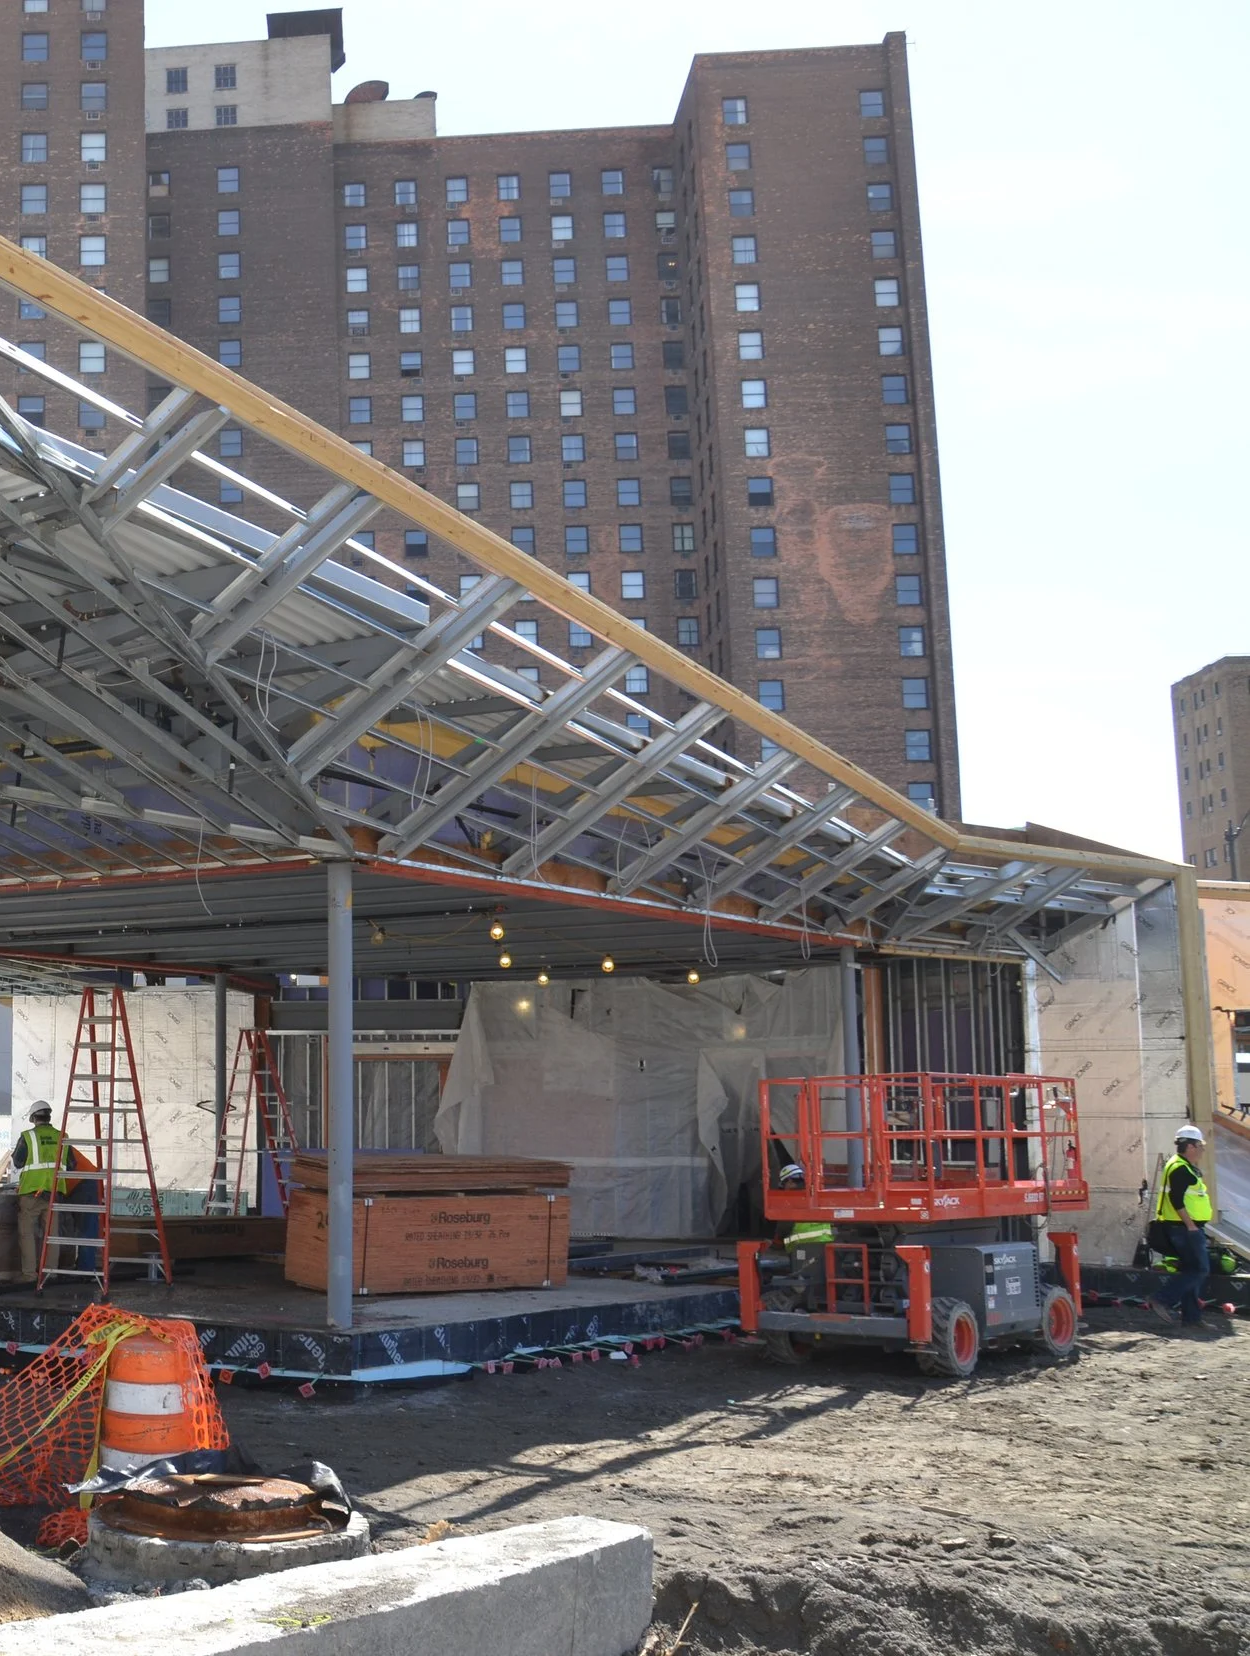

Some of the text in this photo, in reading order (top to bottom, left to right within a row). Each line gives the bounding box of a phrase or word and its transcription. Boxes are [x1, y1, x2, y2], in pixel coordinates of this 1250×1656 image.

[1102, 1078, 1121, 1096] GRACE
[439, 1211, 491, 1225] Roseburg
[436, 1257, 489, 1270] Roseburg
